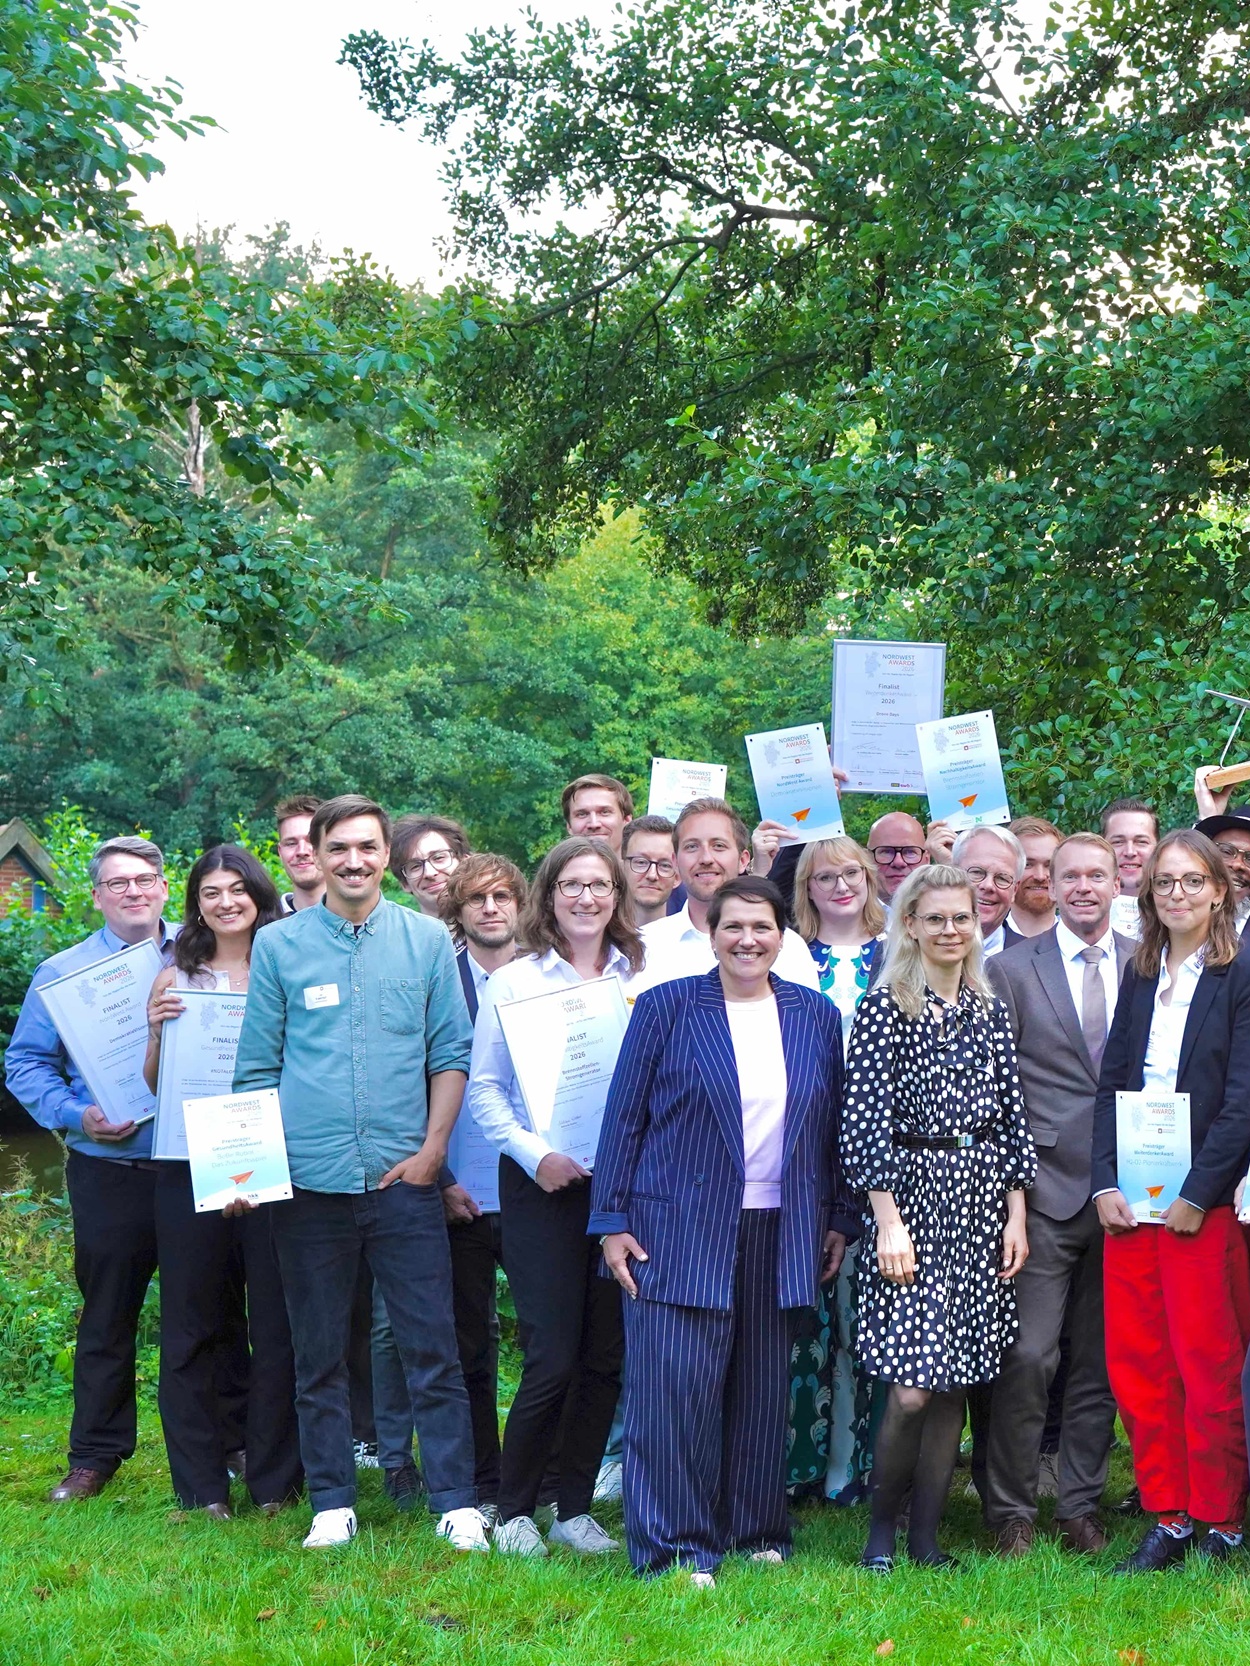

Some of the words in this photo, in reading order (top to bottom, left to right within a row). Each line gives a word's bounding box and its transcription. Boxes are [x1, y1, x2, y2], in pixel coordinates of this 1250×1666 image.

[948, 721, 978, 730] NORDWEST
[955, 726, 980, 735] AWARDS
[778, 734, 809, 743] NORDWEST
[786, 739, 810, 748] AWARDS
[93, 963, 128, 982] NORDWEST
[103, 969, 132, 985] AWARDS
[102, 998, 131, 1013] FINALIST
[117, 1015, 132, 1025] 2026
[570, 1051, 586, 1060] 2026
[224, 1100, 260, 1109] NORDWEST
[232, 1105, 261, 1113] AWARDS
